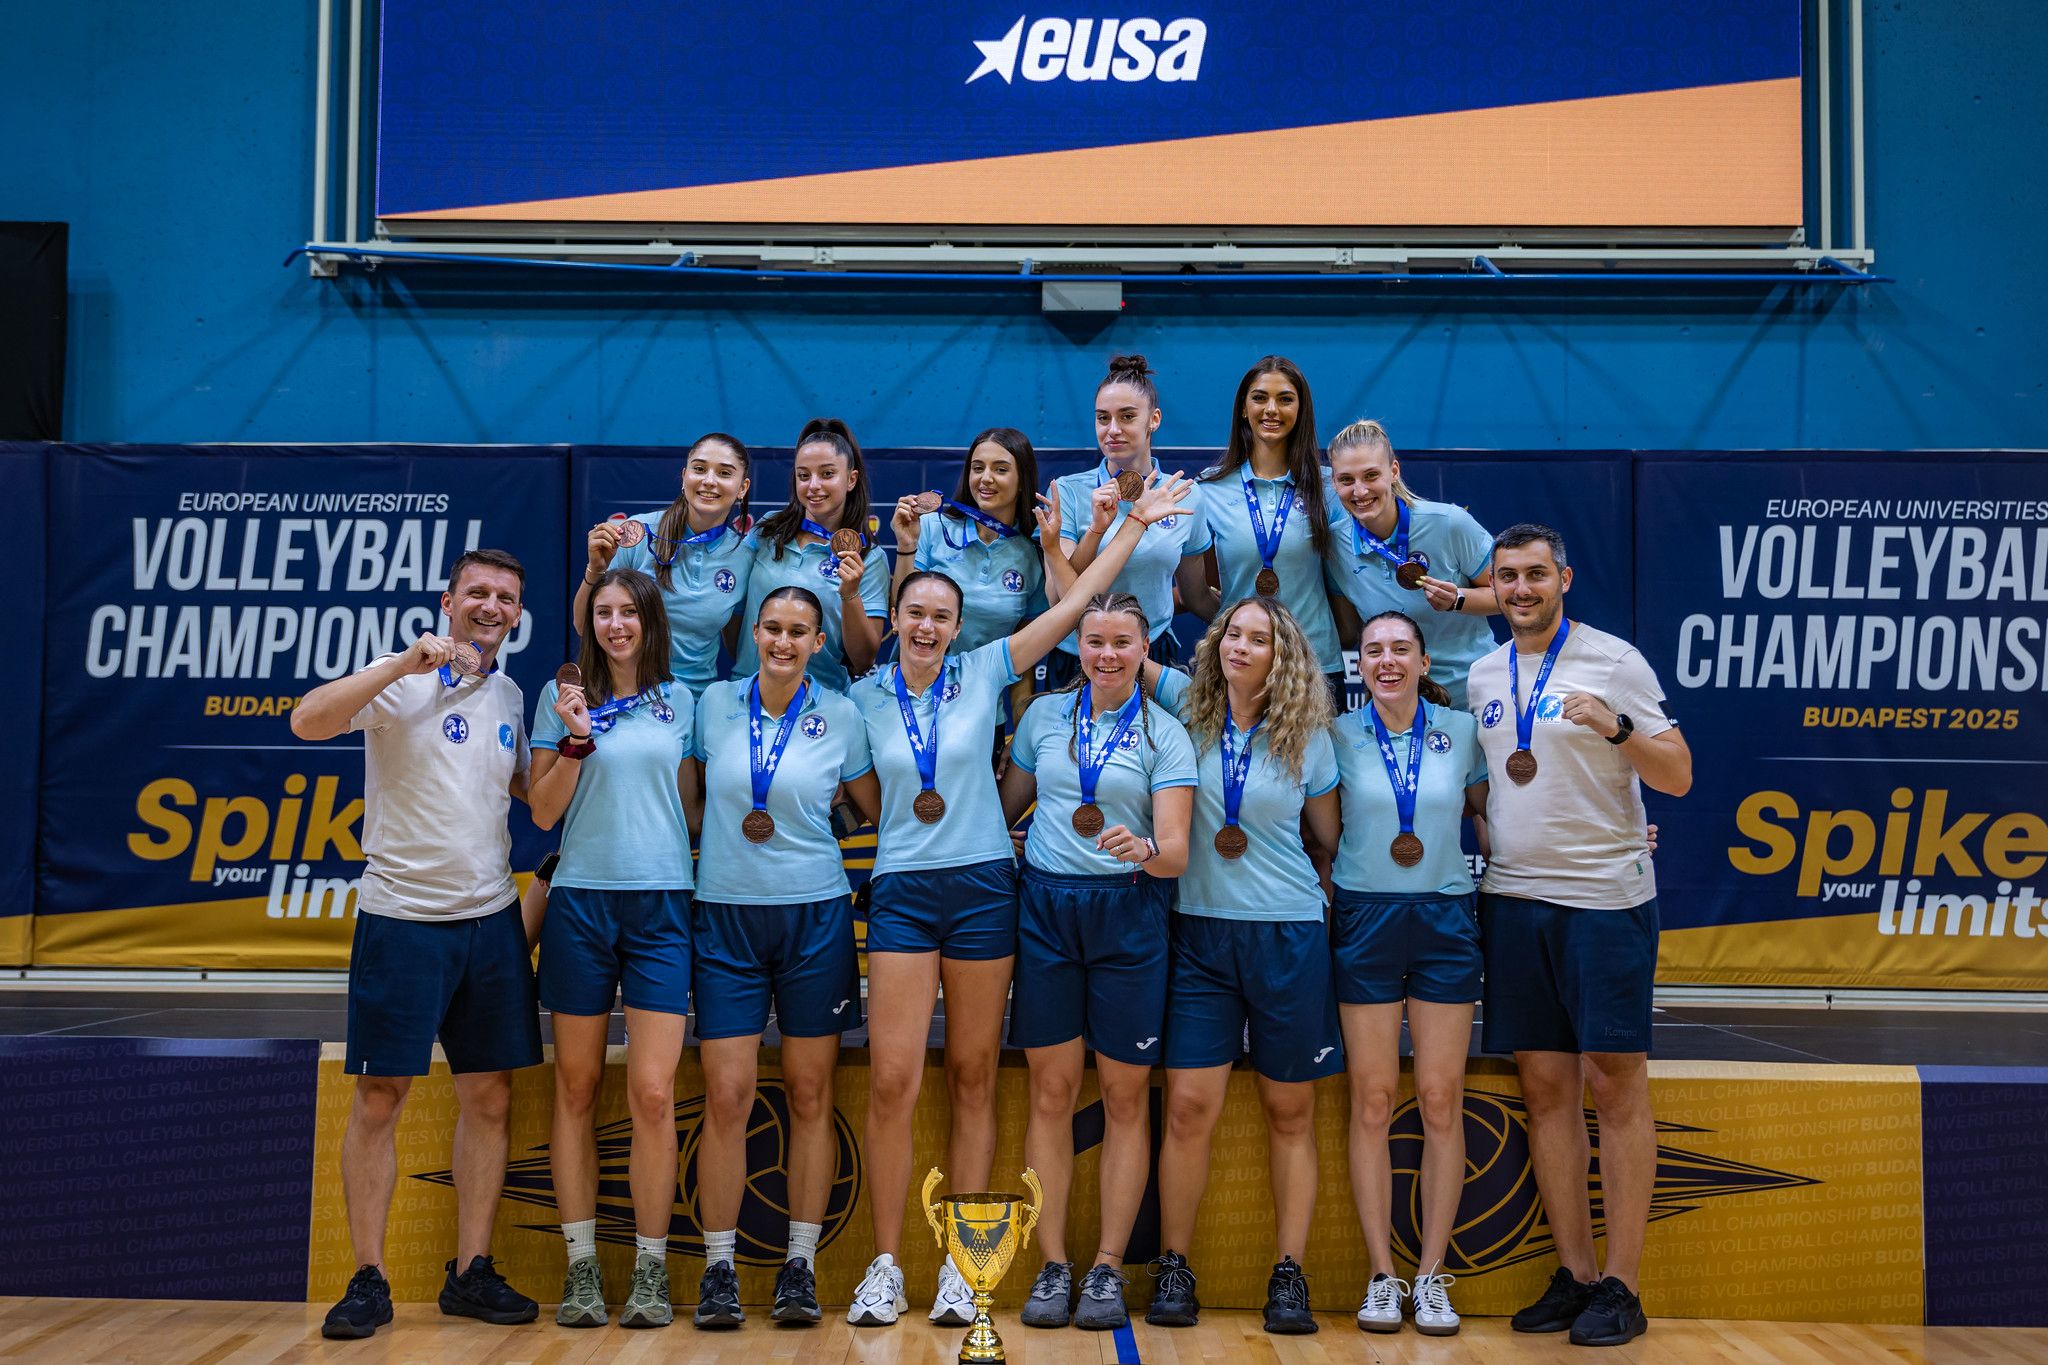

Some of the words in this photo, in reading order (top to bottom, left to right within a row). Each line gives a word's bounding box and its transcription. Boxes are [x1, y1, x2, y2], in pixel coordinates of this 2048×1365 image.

[1021, 17, 1207, 82] eusa
[179, 492, 299, 512] EUROPEAN
[302, 493, 449, 513] UNIVERSITIES
[1765, 499, 1889, 518] EUROPEAN
[1895, 500, 2048, 520] UNIVERSITIES
[85, 604, 533, 680] CHAMPIONSP
[1676, 614, 2048, 692] CHAMPIONS
[204, 696, 301, 716] BUDAP
[1802, 706, 1947, 728] BUDAPEST
[1948, 708, 2019, 730] 2025
[127, 773, 367, 881] Spik
[1727, 787, 2048, 897] Spike
[213, 867, 266, 886] your
[266, 863, 362, 919] lim
[1822, 883, 1876, 902] your
